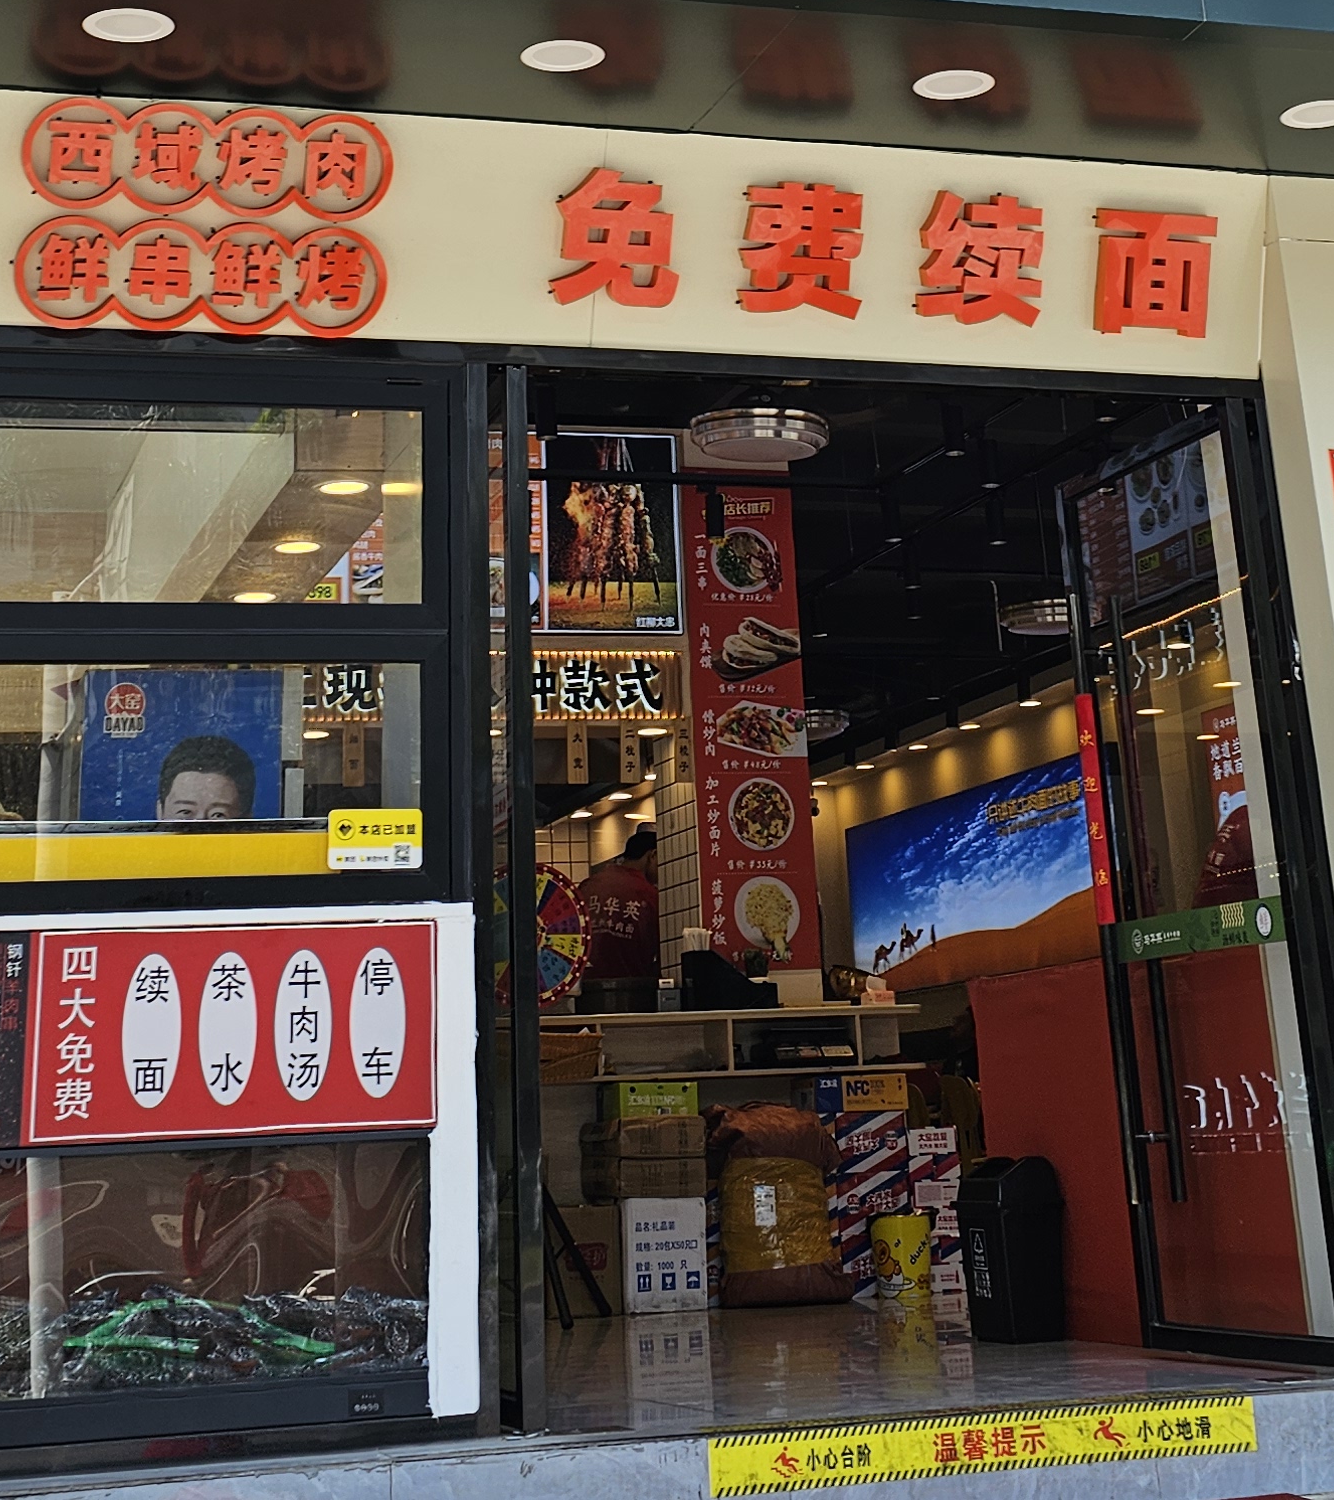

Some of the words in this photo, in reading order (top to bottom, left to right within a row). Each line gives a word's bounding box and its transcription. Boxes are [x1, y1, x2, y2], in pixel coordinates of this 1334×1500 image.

[47, 120, 368, 199] 西域烤肉
[38, 233, 367, 310] 鲜串鲜烤
[549, 167, 1218, 339] 免费续面
[723, 502, 771, 516] 店长推荐
[105, 716, 143, 732] DAYAO
[109, 692, 142, 709] 大窑
[359, 824, 416, 835] 本店已加盟
[705, 776, 720, 857] 加工炒面片
[1078, 730, 1109, 887] 欢迎光临
[588, 895, 641, 921] 马华英
[52, 945, 99, 1122] 四大免费
[133, 964, 170, 1096] 续面
[209, 963, 247, 1091] 茶水
[286, 959, 322, 1089] 牛肉汤
[359, 957, 395, 1086] 停车
[846, 1080, 870, 1097] NFC
[805, 1446, 872, 1473] 小心台阶
[932, 1425, 1047, 1464] 温馨提示
[1137, 1415, 1212, 1442] 小心地滑
